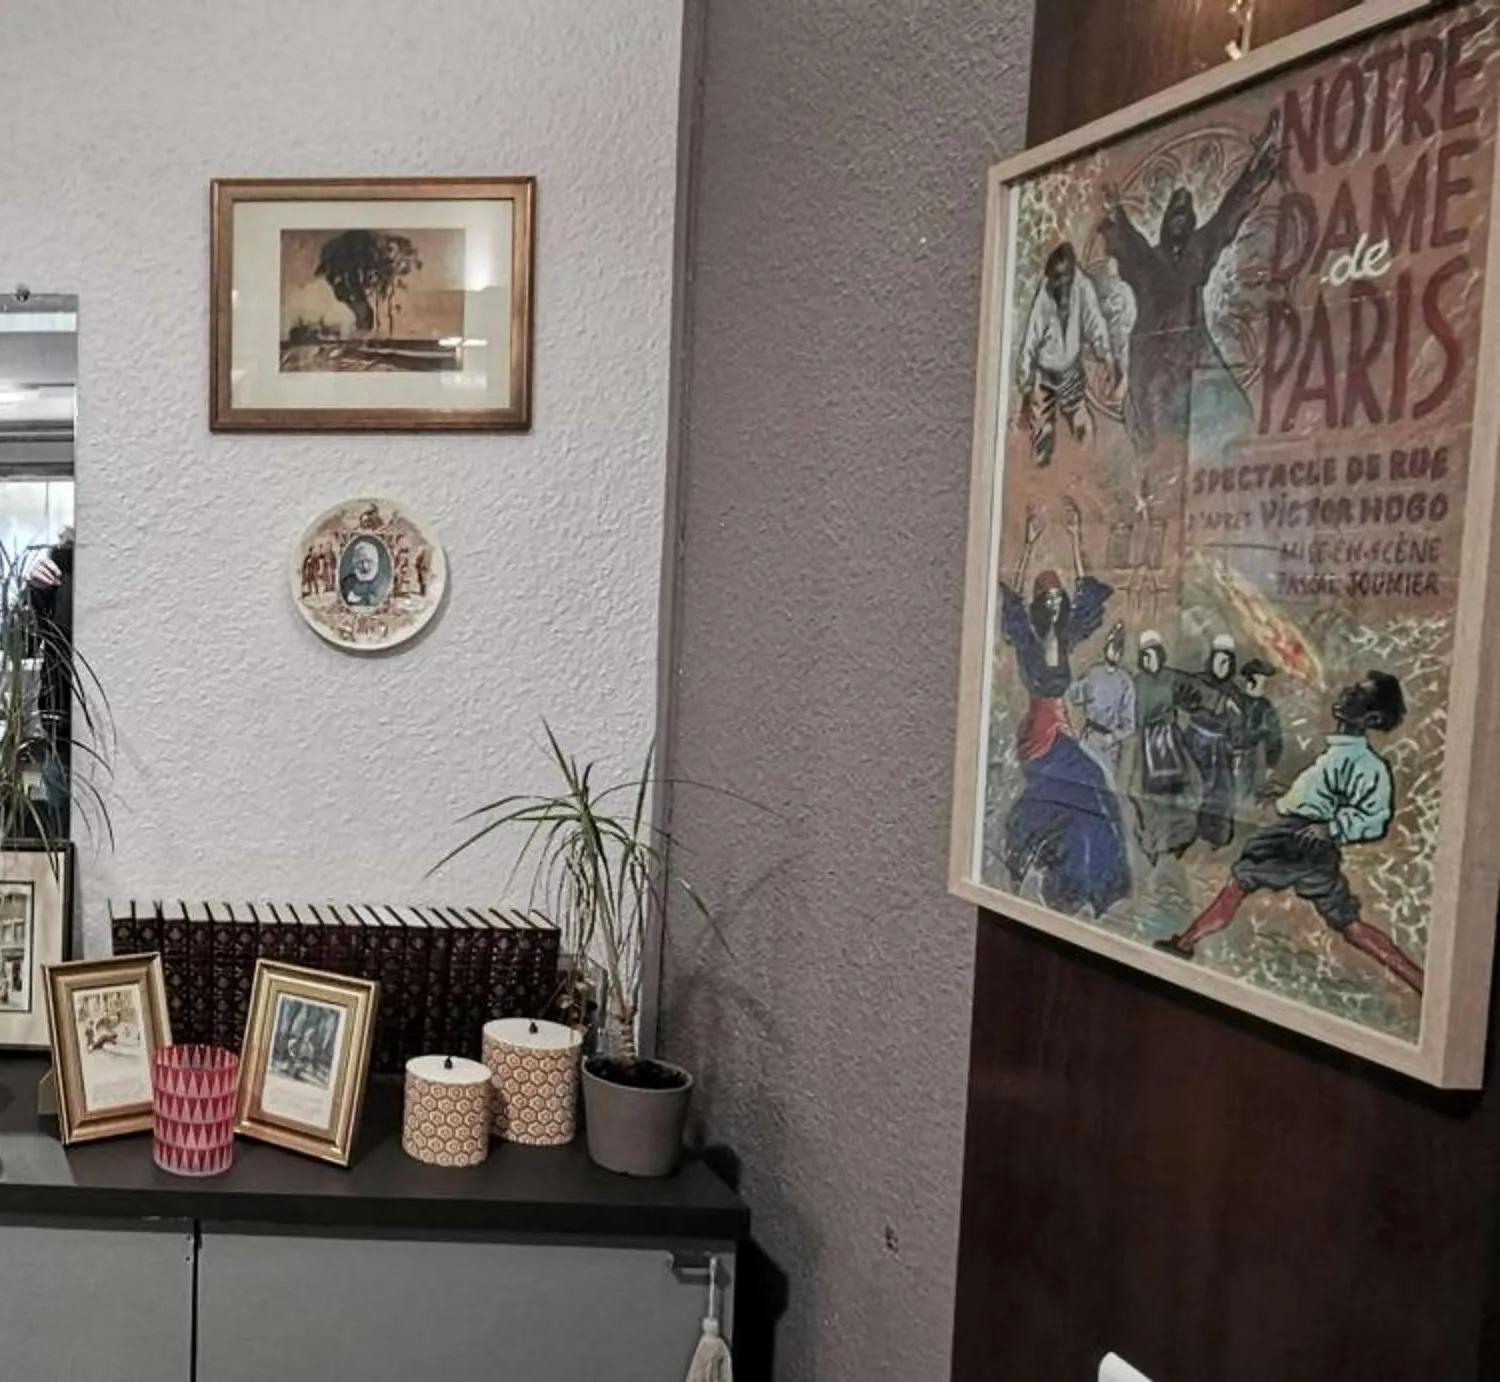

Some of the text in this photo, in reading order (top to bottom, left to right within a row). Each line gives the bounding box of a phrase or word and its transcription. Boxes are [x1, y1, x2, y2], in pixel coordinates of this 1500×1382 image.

[1280, 16, 1488, 174] NOTRE
[1270, 138, 1479, 282] DAME
[1320, 232, 1392, 287] de
[1258, 255, 1470, 434] PARIS
[1193, 457, 1337, 494] SPECTACLE
[1346, 454, 1381, 484] DE
